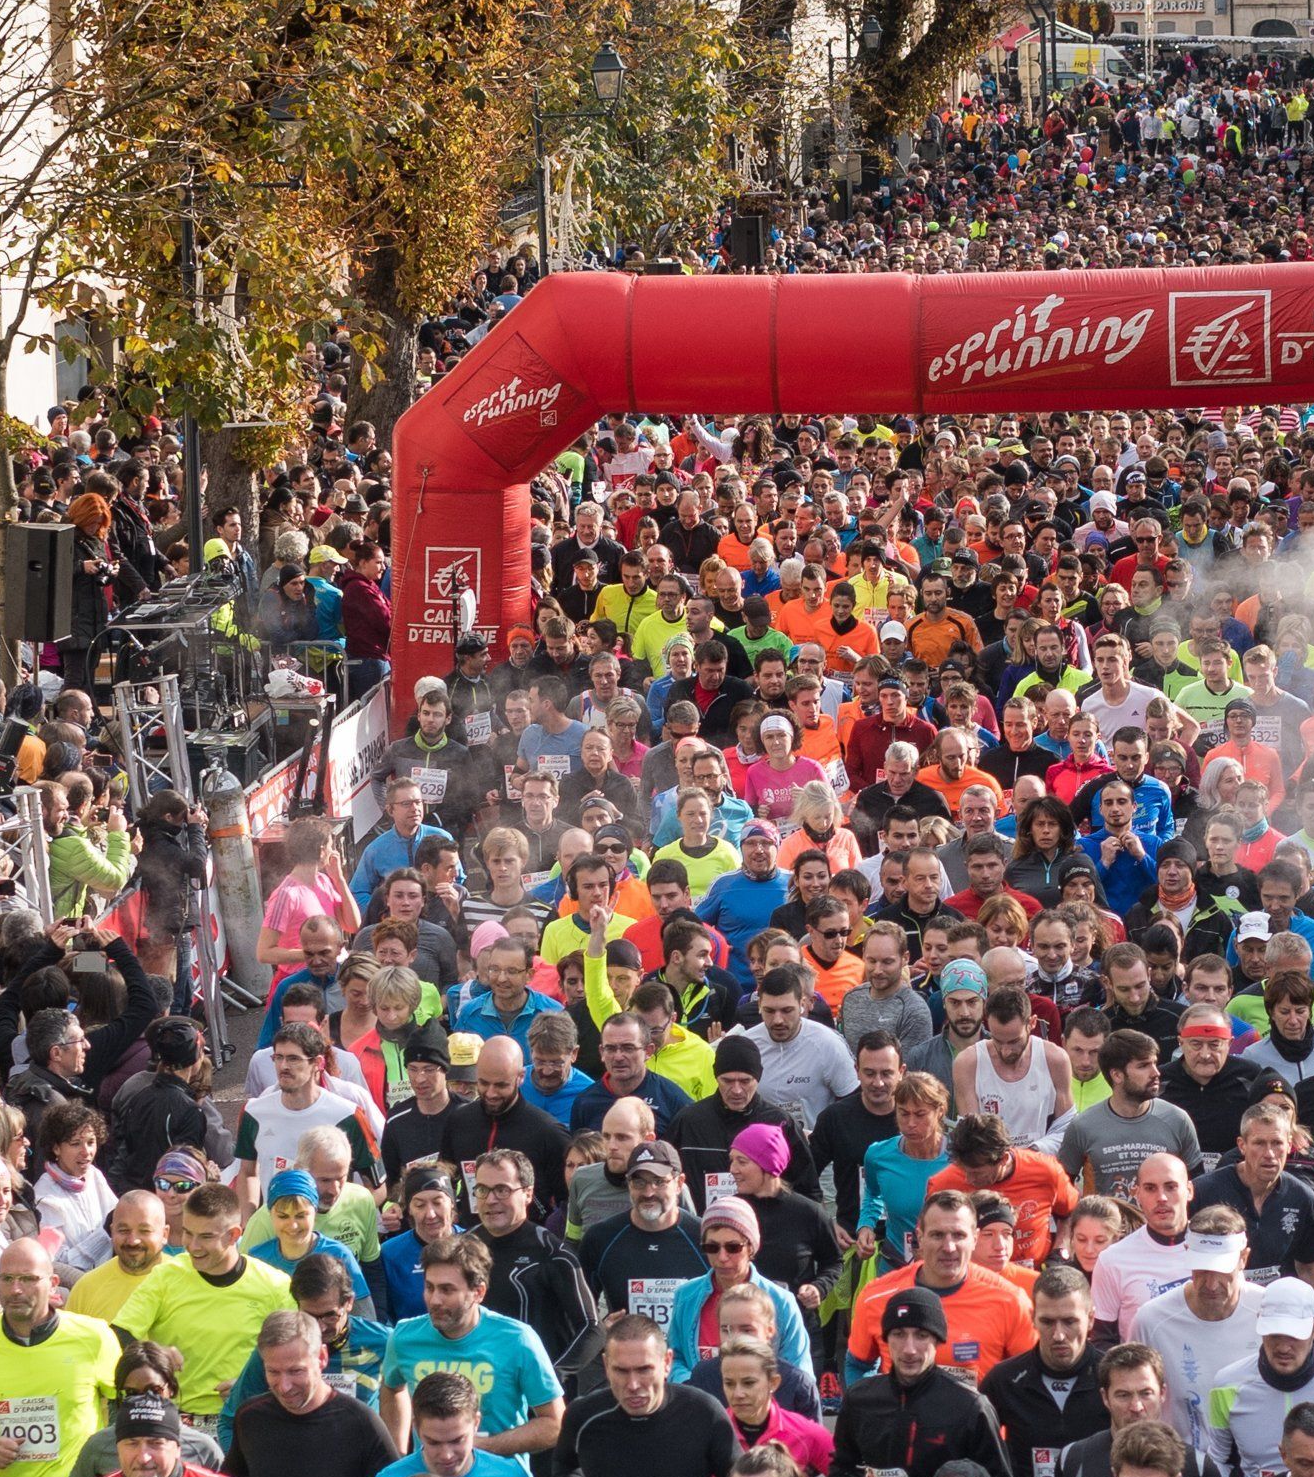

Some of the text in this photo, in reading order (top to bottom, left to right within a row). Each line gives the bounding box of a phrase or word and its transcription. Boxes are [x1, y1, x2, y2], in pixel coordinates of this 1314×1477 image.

[928, 294, 1065, 382] esprit
[962, 309, 1154, 384] running
[463, 376, 522, 423] esprit
[478, 383, 561, 426] running
[420, 783, 444, 796] 628
[1102, 1143, 1167, 1155] SEMI-MARATHON
[1, 1424, 57, 1444] 4903
